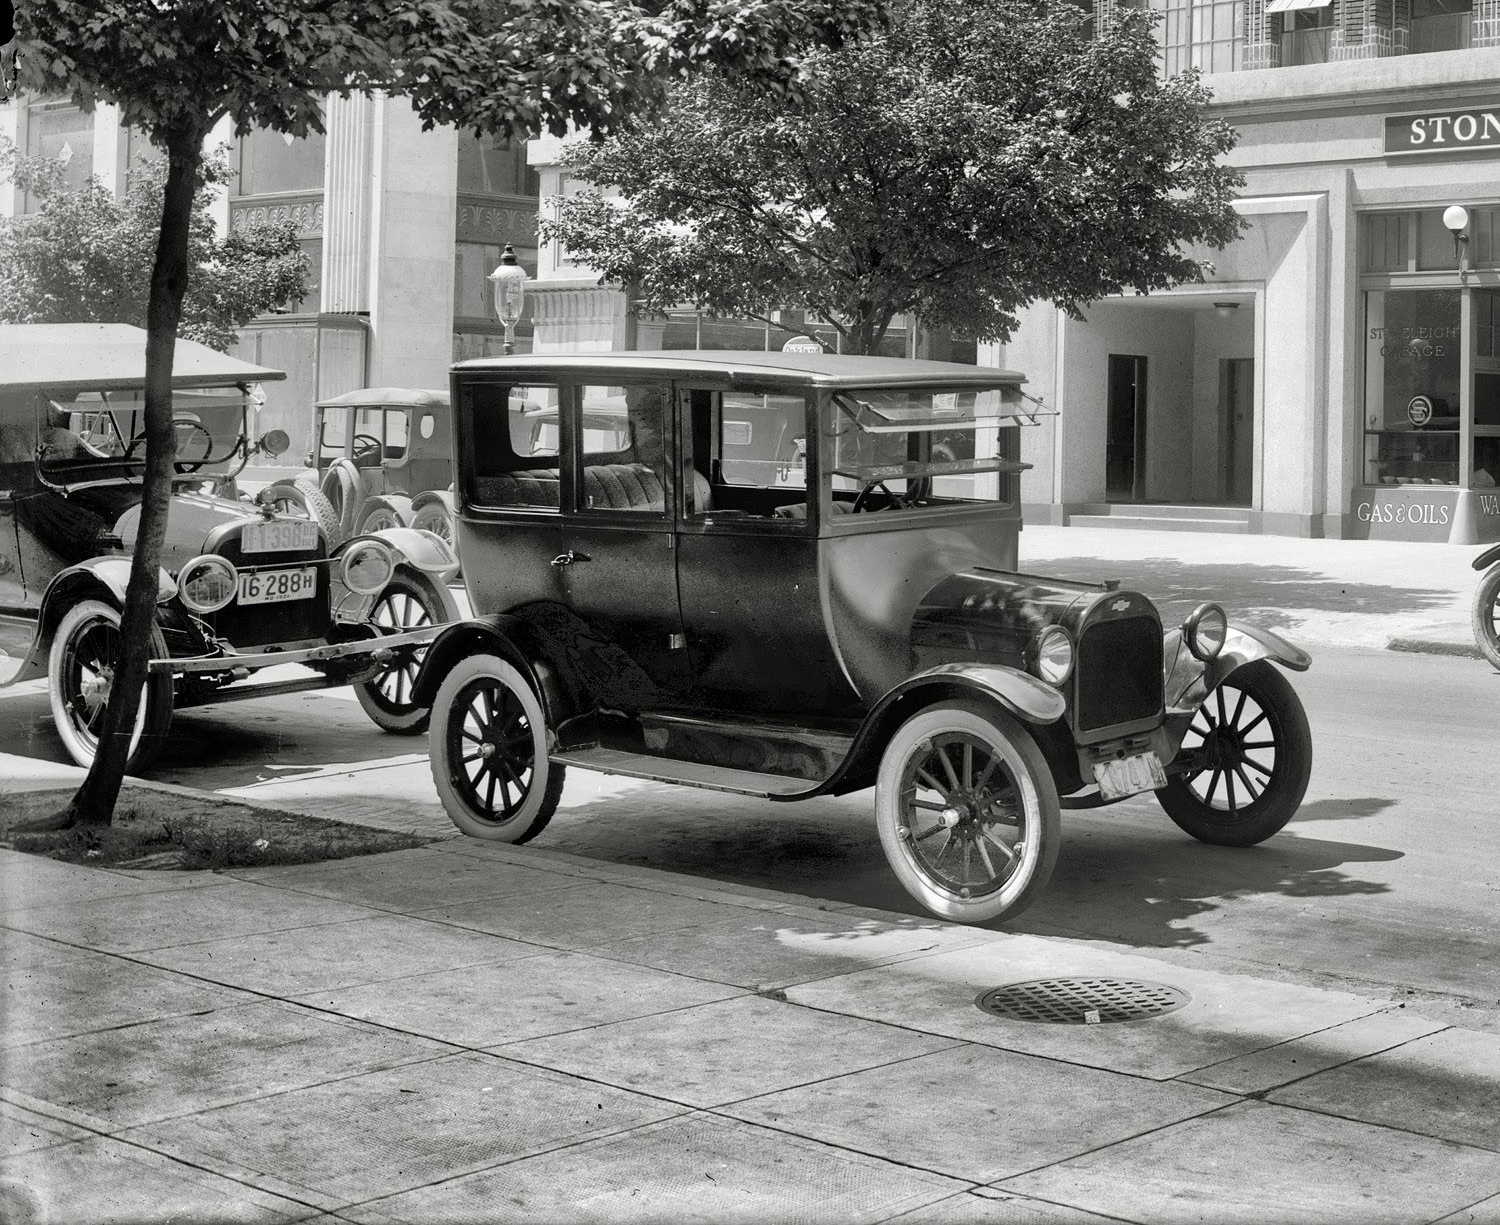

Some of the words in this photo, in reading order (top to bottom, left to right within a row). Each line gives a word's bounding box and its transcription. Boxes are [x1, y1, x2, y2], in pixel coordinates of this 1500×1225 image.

[1370, 327, 1457, 340] STELEIGH
[1357, 502, 1394, 523] GAS
[1408, 504, 1449, 525] OILS
